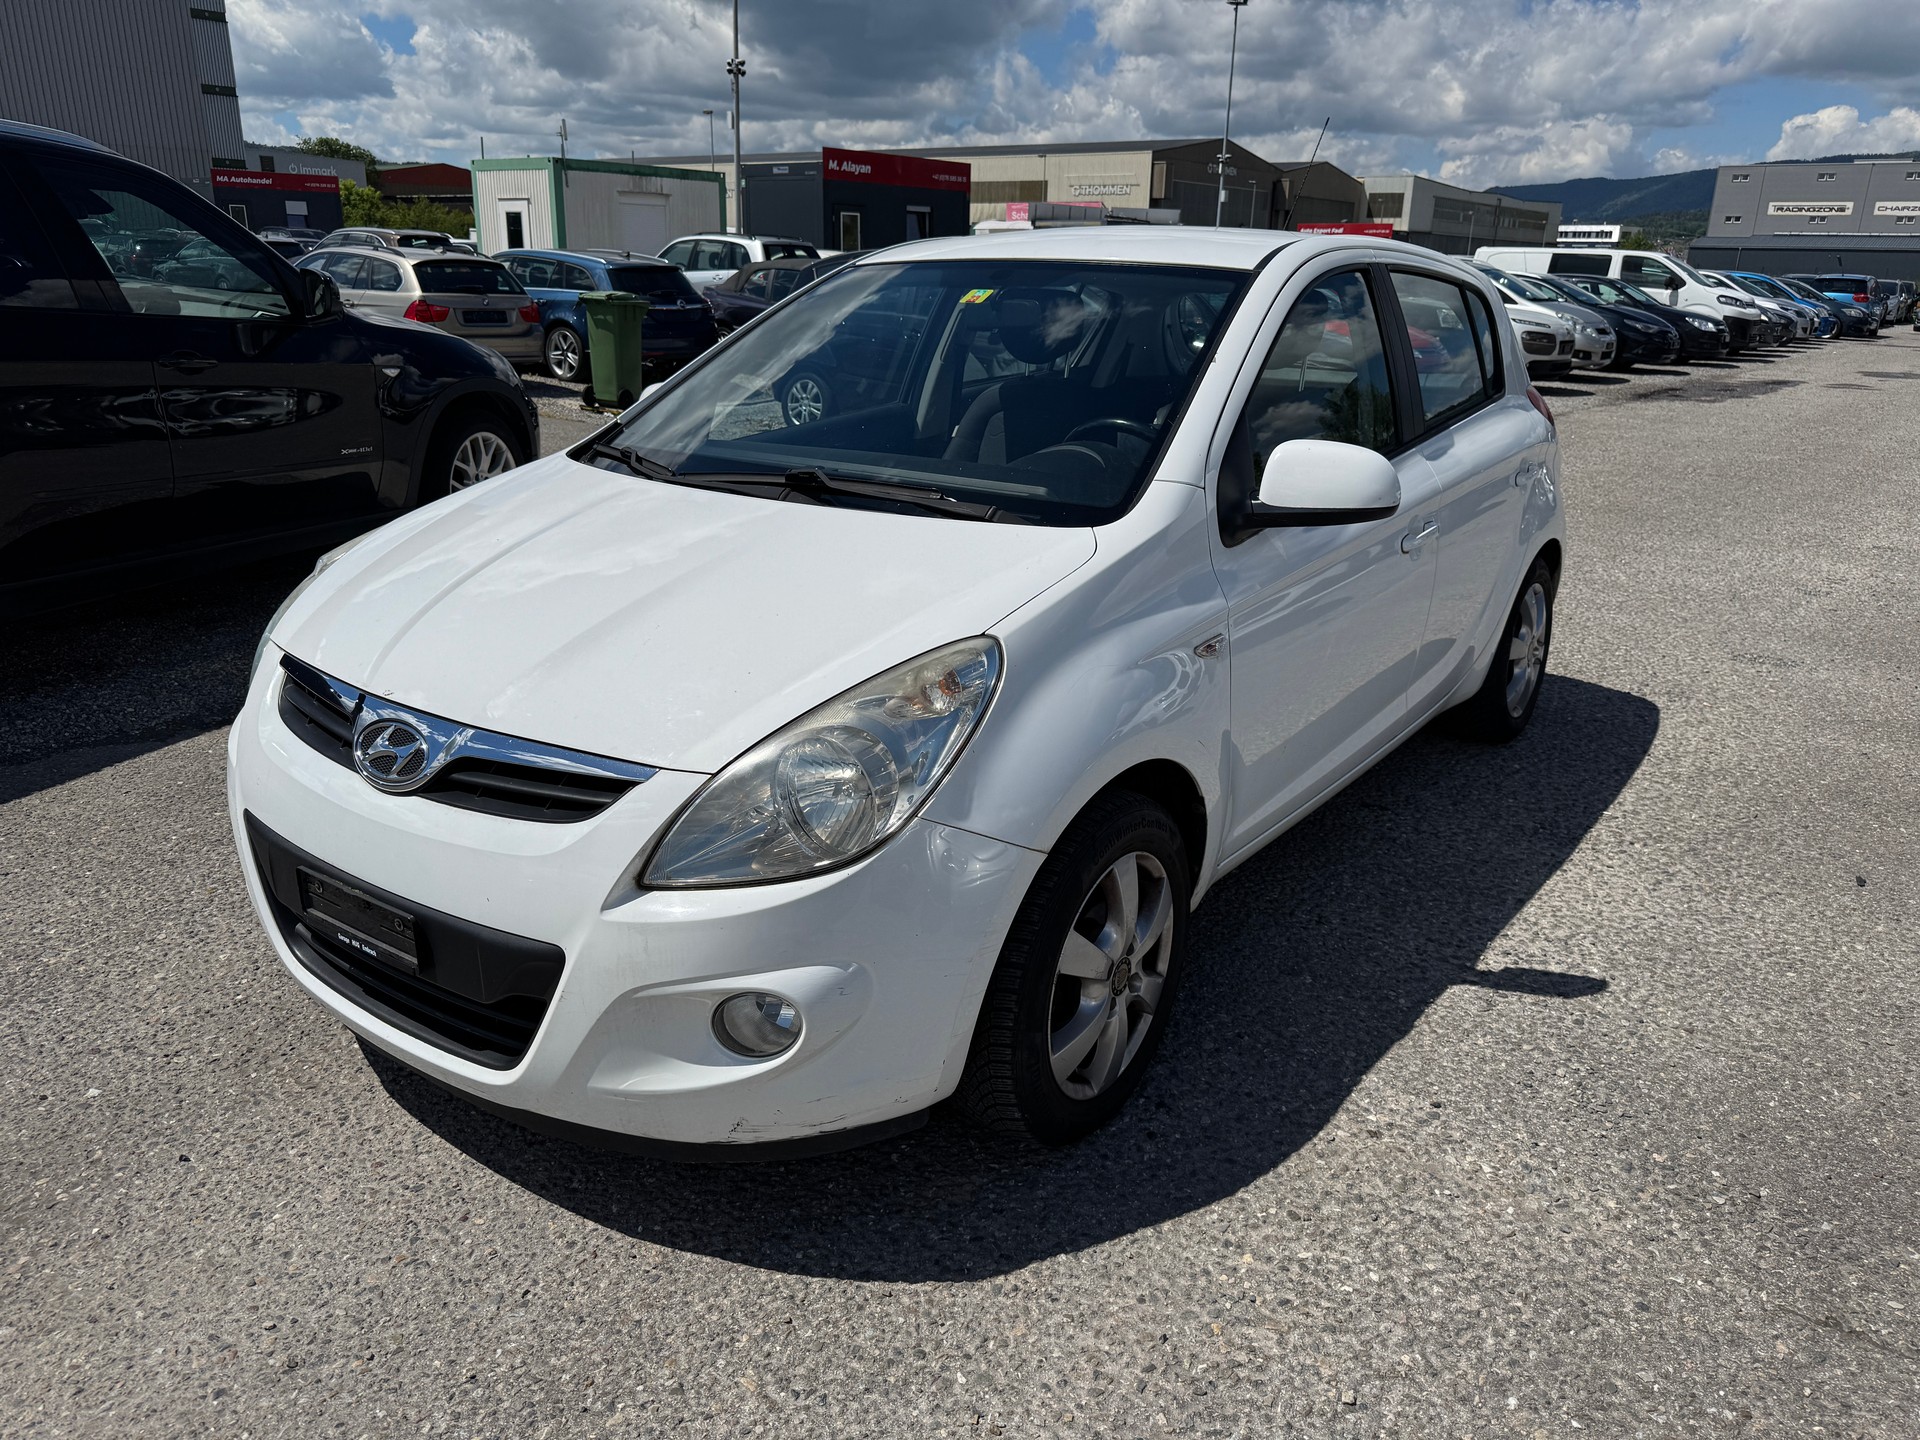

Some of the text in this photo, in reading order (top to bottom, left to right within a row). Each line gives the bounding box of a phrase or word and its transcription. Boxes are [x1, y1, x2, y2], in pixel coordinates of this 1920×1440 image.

[828, 160, 871, 175] M. Alayan
[230, 176, 273, 185] Autohandel
